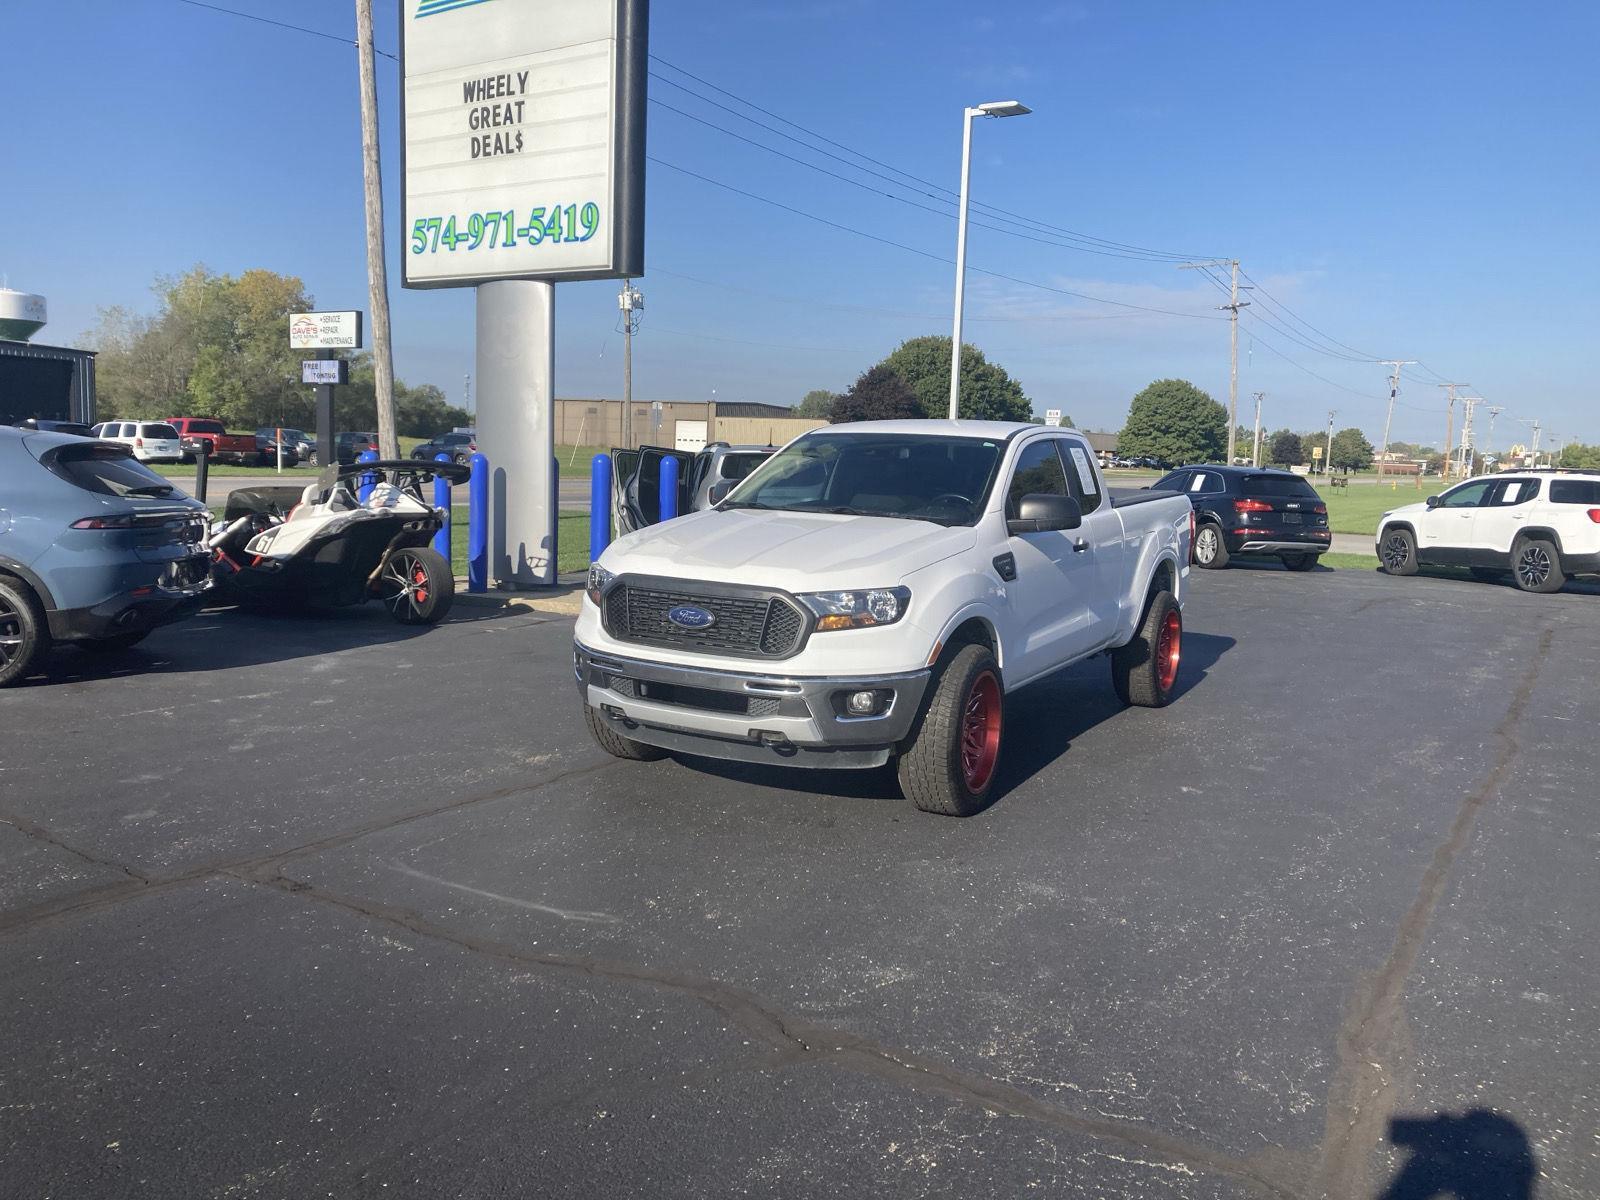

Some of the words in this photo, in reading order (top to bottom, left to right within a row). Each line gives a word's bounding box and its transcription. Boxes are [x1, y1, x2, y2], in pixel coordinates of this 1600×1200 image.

[462, 71, 529, 104] WHEELY
[468, 101, 525, 130] GREAT
[471, 130, 523, 159] DEAL$
[411, 201, 600, 255] 574-971-5419
[322, 315, 341, 323] SERVICE
[291, 327, 318, 335] DAVE'S
[322, 326, 339, 334] REPAIR
[322, 336, 353, 345] MAINTENANCE
[255, 535, 274, 553] 61
